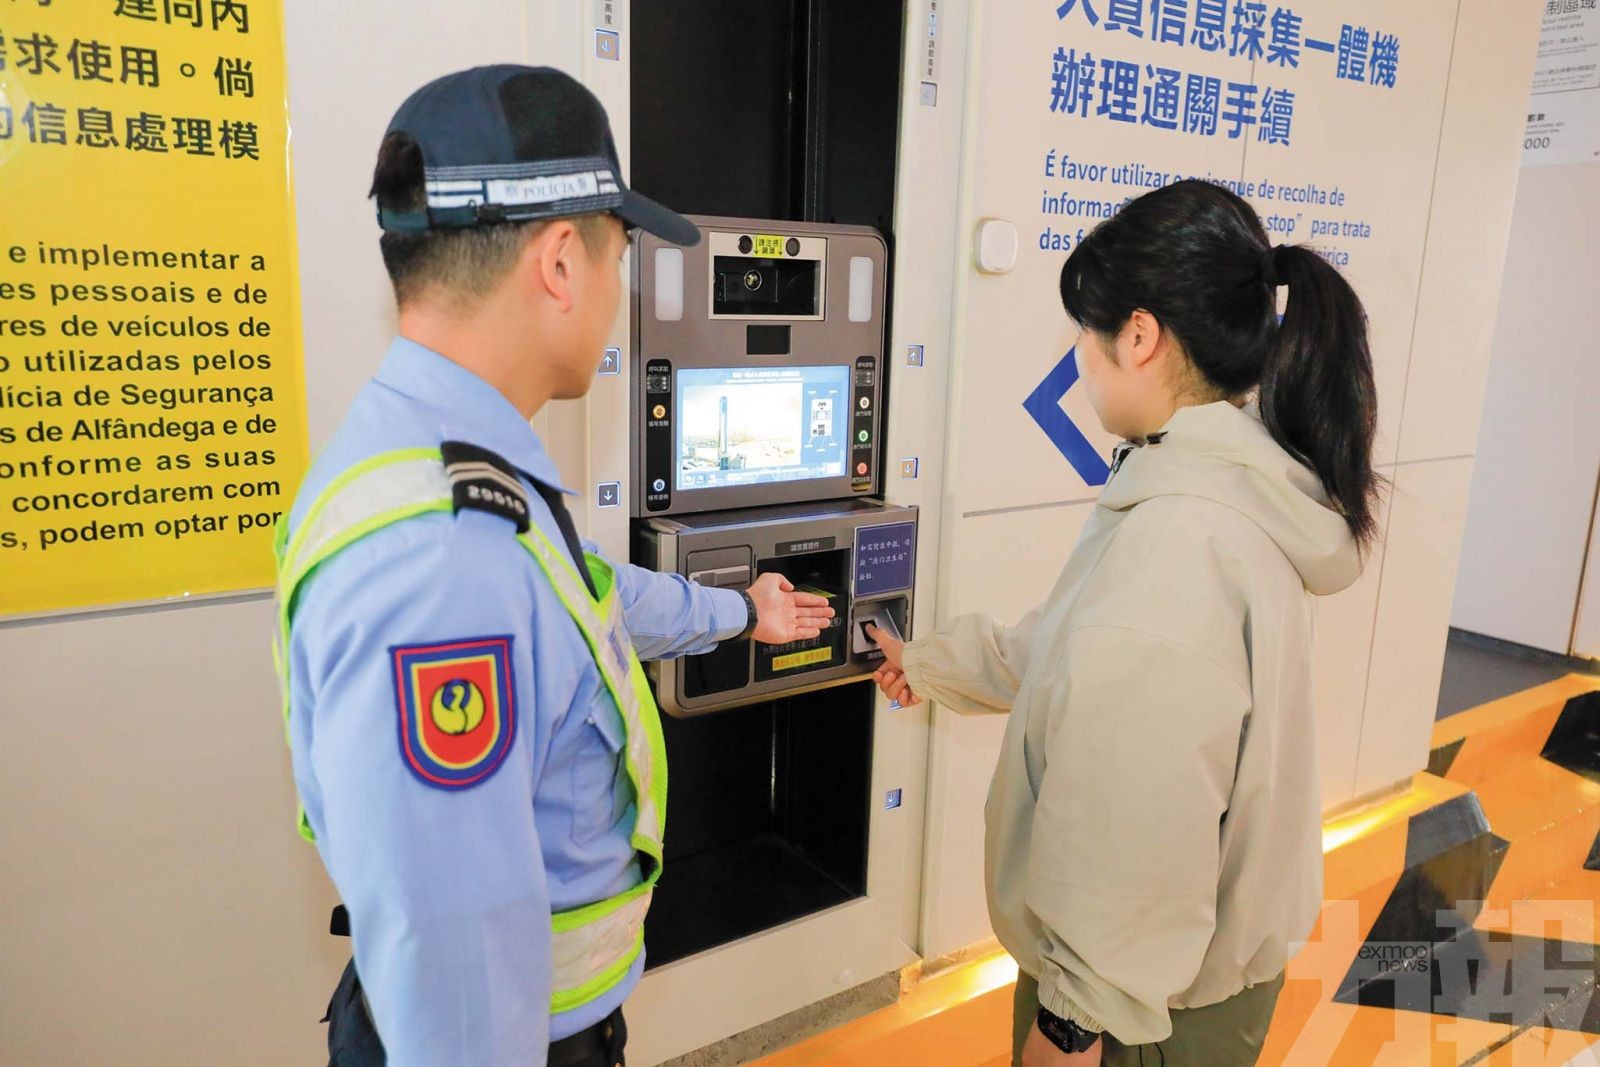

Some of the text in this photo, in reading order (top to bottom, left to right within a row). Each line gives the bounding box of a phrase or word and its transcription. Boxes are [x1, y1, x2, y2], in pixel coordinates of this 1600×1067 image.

[0, 30, 255, 98] 求使用。倘
[1049, 46, 1296, 147] 辦理通關手續
[1045, 149, 1056, 177] É
[1061, 155, 1107, 182] favor
[1111, 163, 1170, 188] utilizar
[1258, 179, 1275, 199] de
[1278, 184, 1327, 204] recolha
[1329, 187, 1345, 206] de
[1039, 227, 1071, 251] das
[1310, 219, 1339, 239] para
[1342, 220, 1372, 238] trata
[9, 241, 266, 271] e implementar a
[50, 281, 195, 306] pessoais
[206, 287, 223, 304] e
[233, 283, 268, 304] de
[61, 314, 98, 337] de
[107, 315, 229, 337] veículos
[238, 316, 272, 337] de
[24, 349, 180, 373] utilizadas
[193, 349, 272, 375] pelos
[73, 384, 110, 407] de
[121, 384, 274, 410] Segurança
[26, 421, 63, 443] de
[71, 417, 215, 442] Alfândega
[222, 419, 238, 435] e
[245, 414, 277, 434] de
[156, 453, 192, 471] as
[204, 449, 276, 468] suas
[12, 480, 281, 513] concordarem com
[40, 520, 144, 550] podem
[154, 513, 229, 539] optar
[237, 511, 282, 534] por
